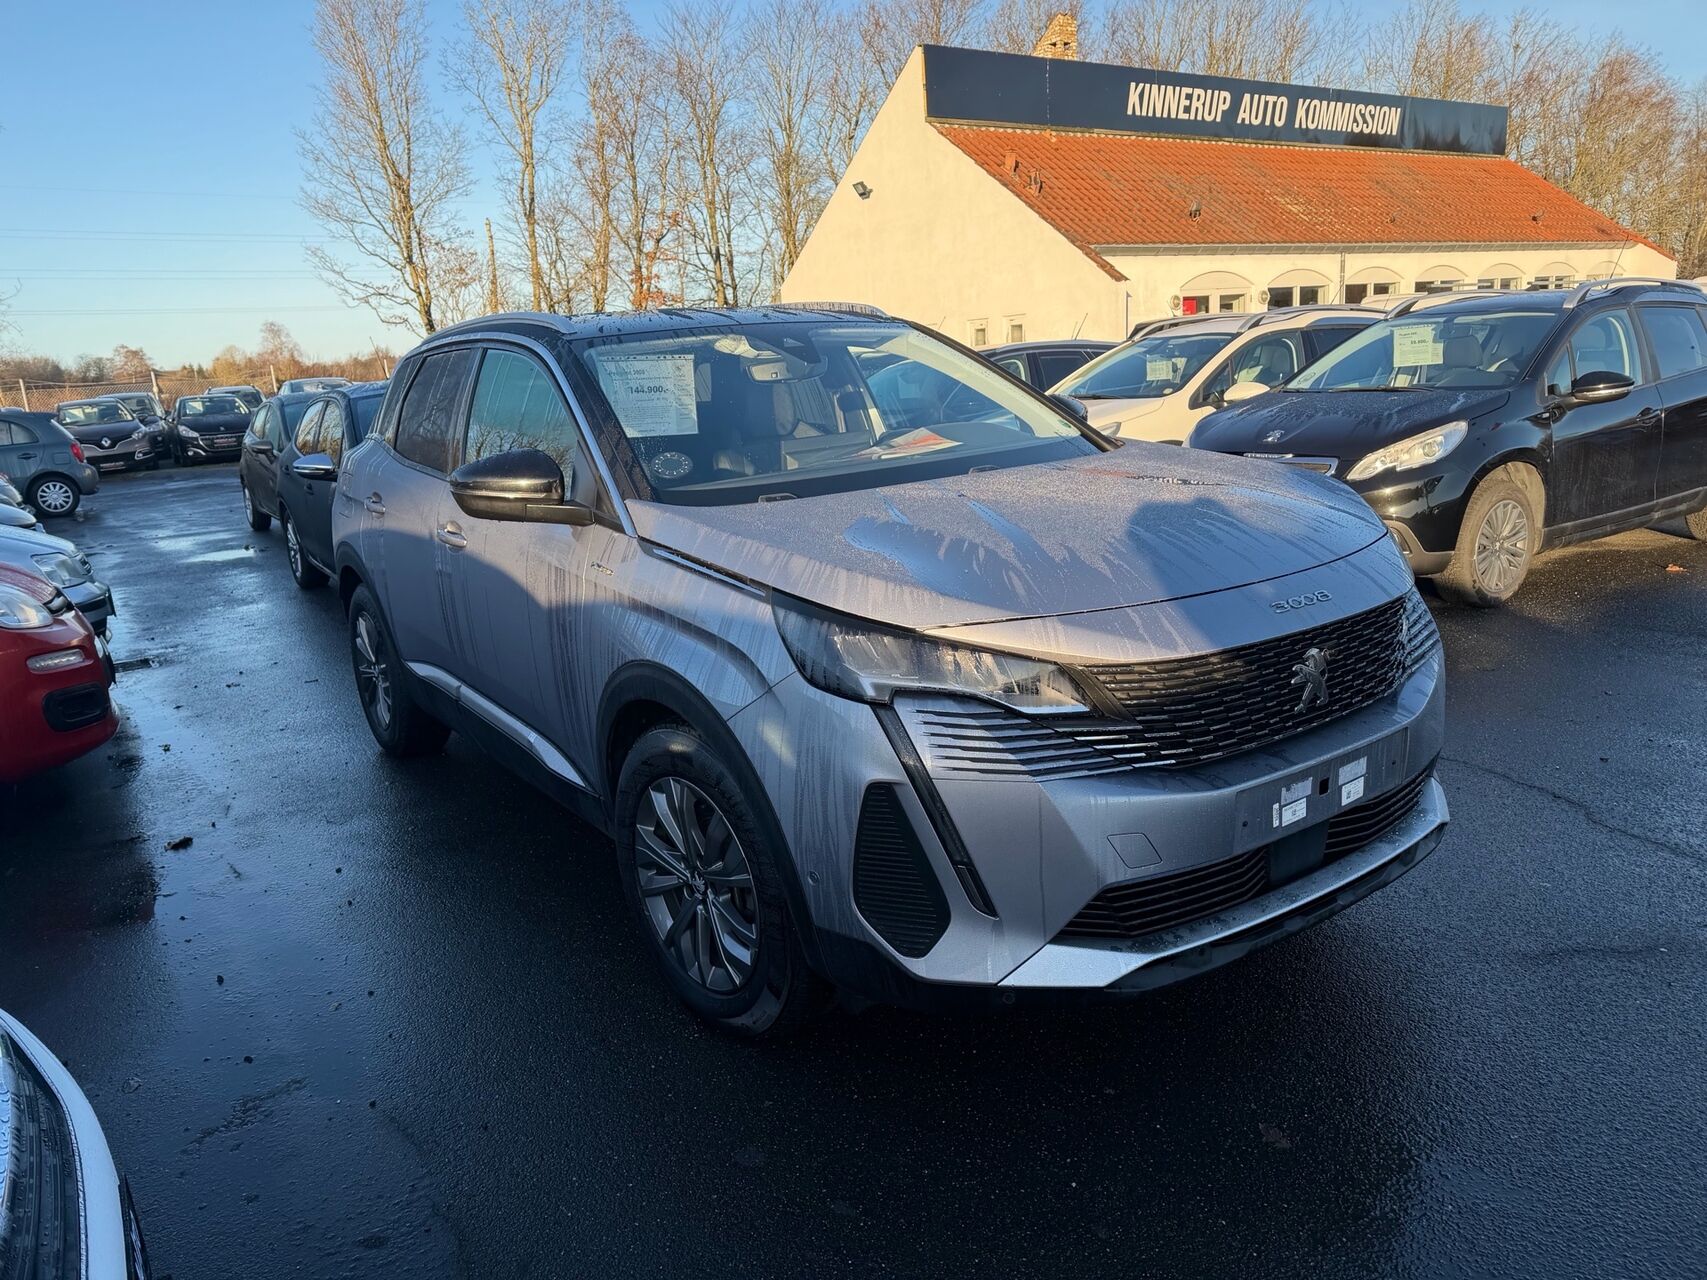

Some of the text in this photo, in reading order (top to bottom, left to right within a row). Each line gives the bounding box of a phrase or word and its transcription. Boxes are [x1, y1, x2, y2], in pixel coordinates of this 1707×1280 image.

[1126, 82, 1402, 136] KINNERUP AUTO KOMMISSION
[1270, 589, 1333, 613] 3008
